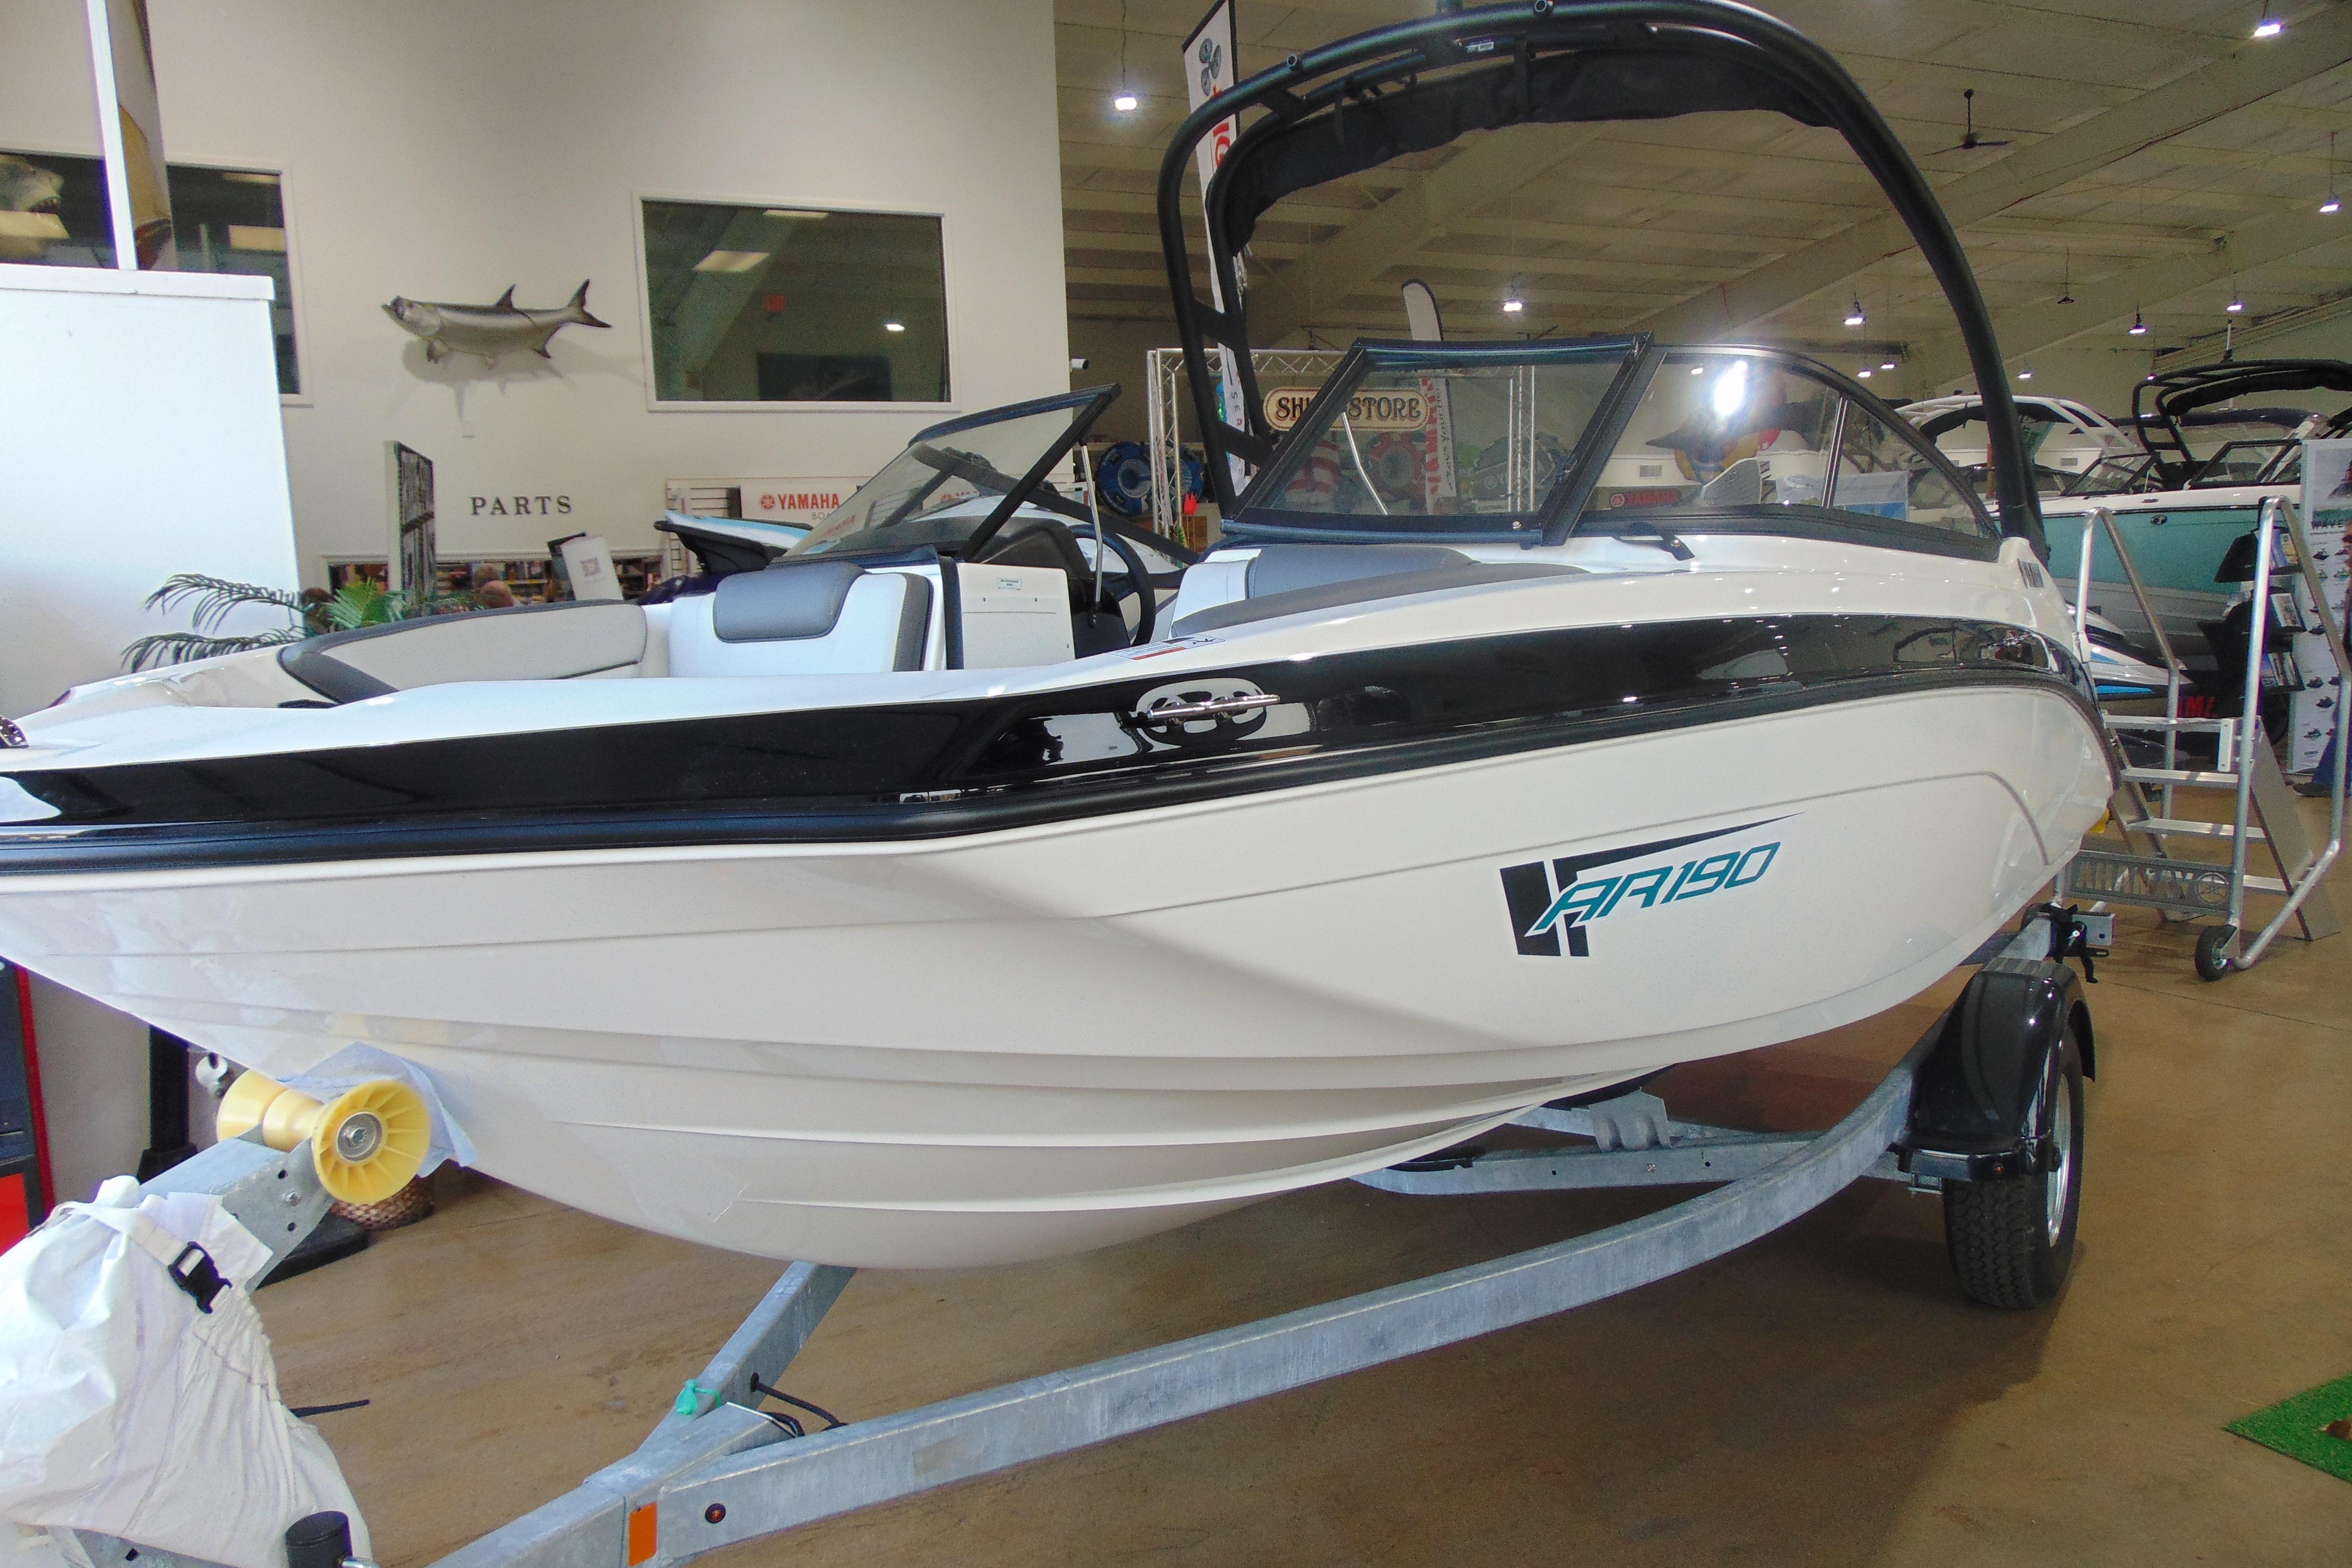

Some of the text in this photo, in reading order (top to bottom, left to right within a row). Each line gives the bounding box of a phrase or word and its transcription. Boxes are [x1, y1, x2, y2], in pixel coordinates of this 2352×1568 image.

[1347, 396, 1422, 420] STORE
[470, 495, 571, 515] PARTS
[778, 493, 841, 509] YAMAHA
[1529, 841, 1782, 933] AR190
